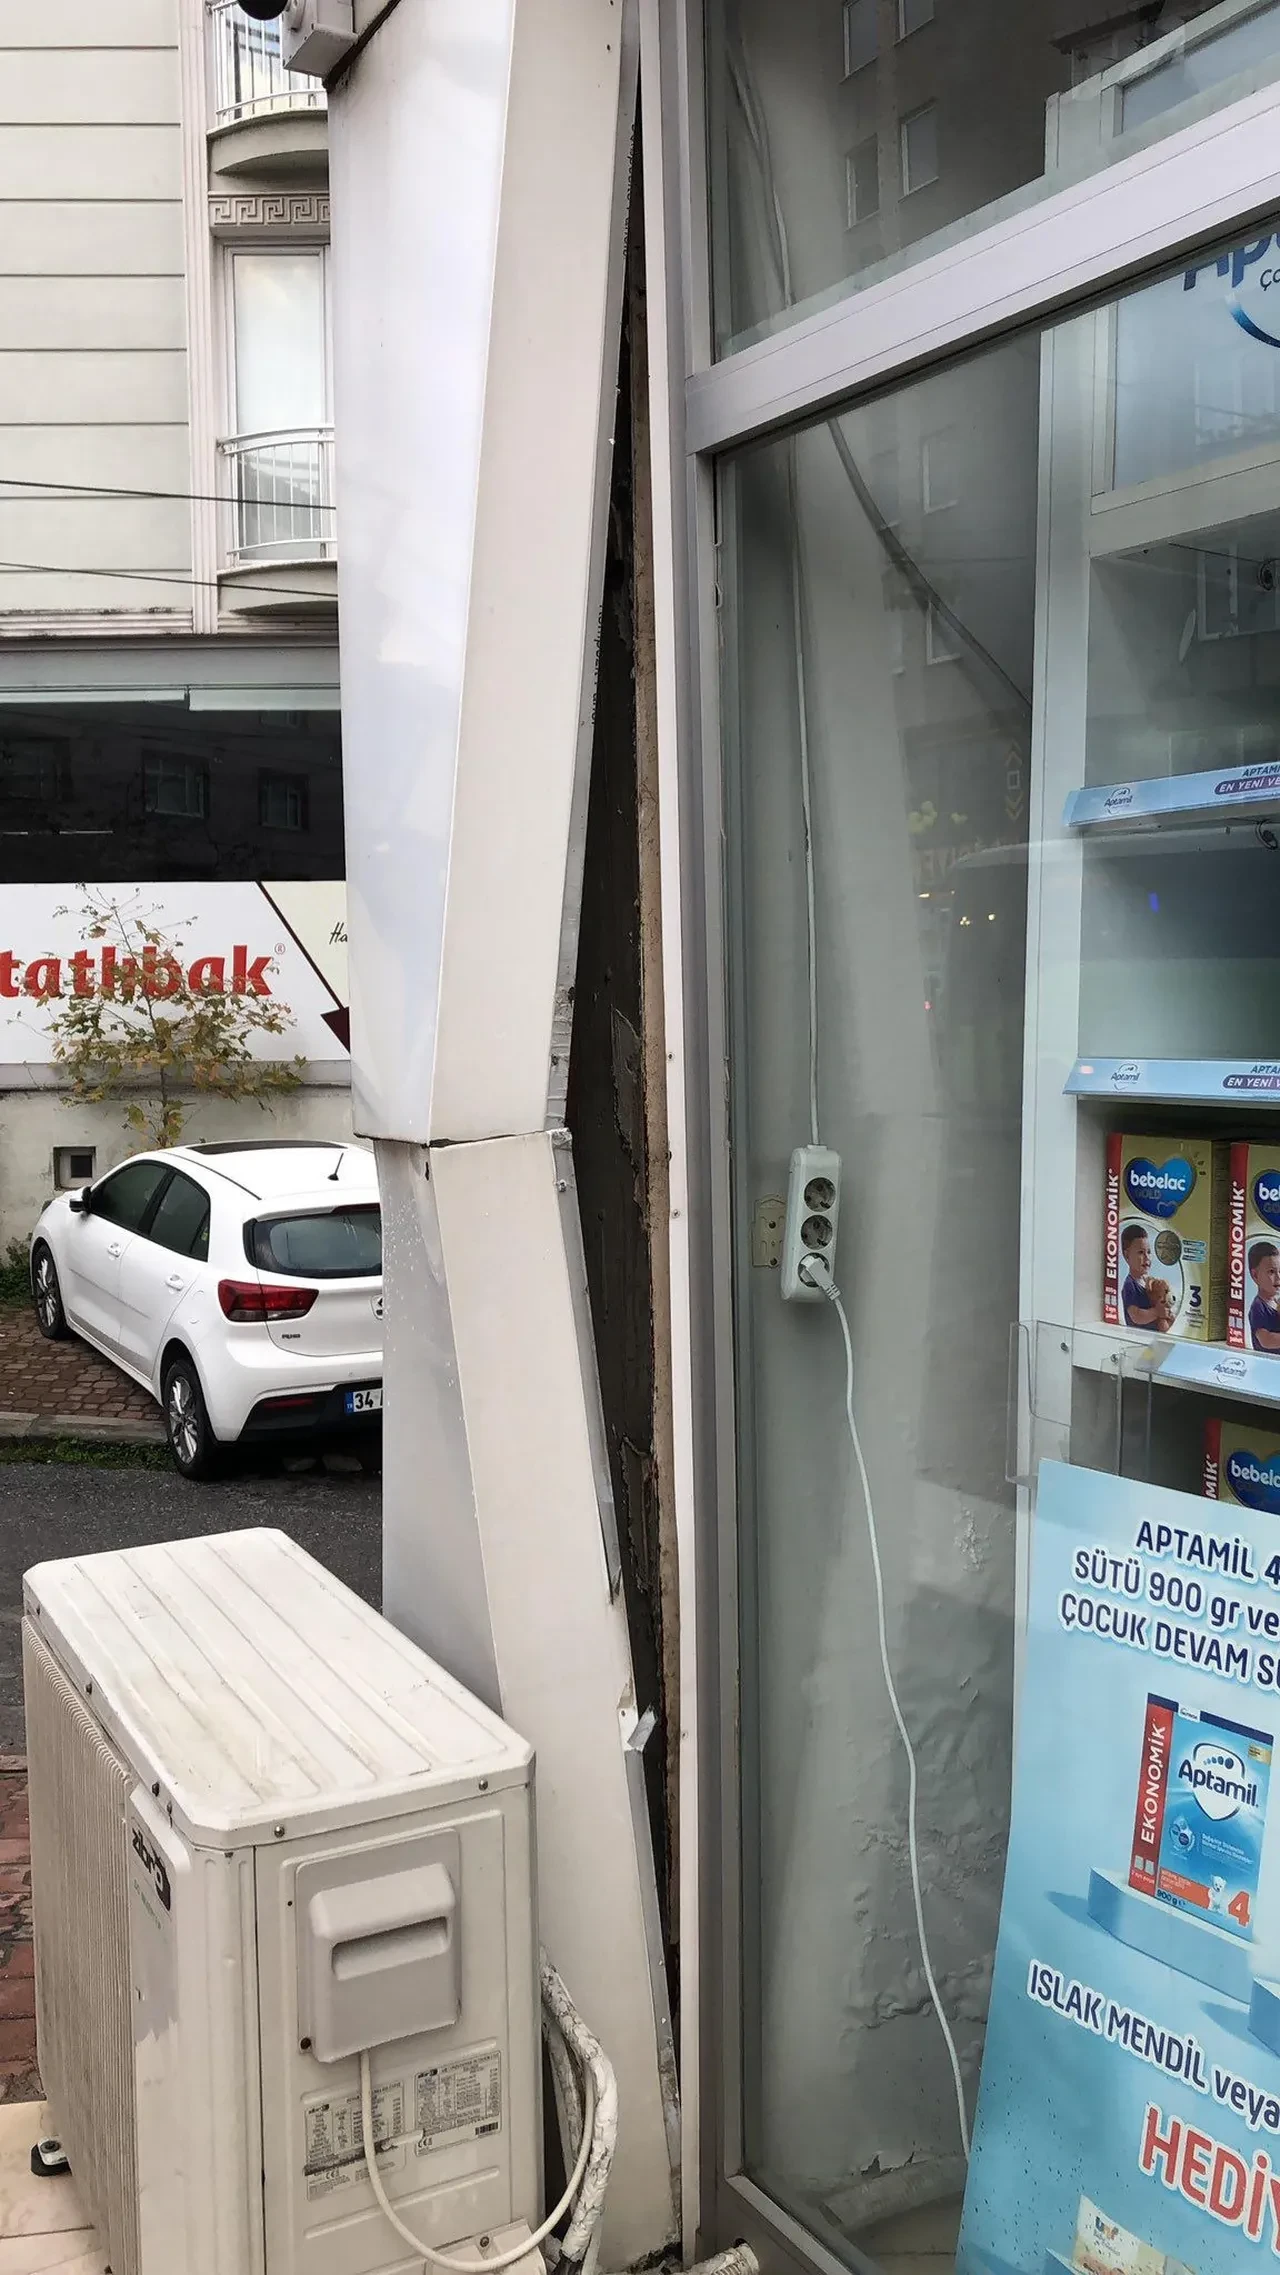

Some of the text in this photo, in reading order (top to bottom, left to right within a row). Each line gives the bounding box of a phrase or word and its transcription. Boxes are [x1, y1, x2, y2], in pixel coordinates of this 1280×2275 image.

[1219, 782, 1235, 792] EN
[1227, 1077, 1243, 1087] EN
[1247, 1077, 1273, 1088] YENİ
[1130, 1170, 1186, 1191] bebelac
[1106, 1173, 1120, 1280] EKONOMİK
[1230, 1188, 1245, 1300] EKONOMİK
[1189, 1285, 1202, 1307] 3
[355, 1391, 374, 1410] 34
[1136, 1521, 1254, 1578] APTAMİL
[1075, 1549, 1280, 1636] SÜTÜ 900 gr ve
[1061, 1593, 1147, 1646] ÇOCUK
[1155, 1621, 1248, 1678] DEVAM
[1140, 1723, 1166, 1844] EKONOMİK
[1228, 1891, 1250, 1927] 4
[1030, 1964, 1280, 2129] ISLAK MENDİL veya
